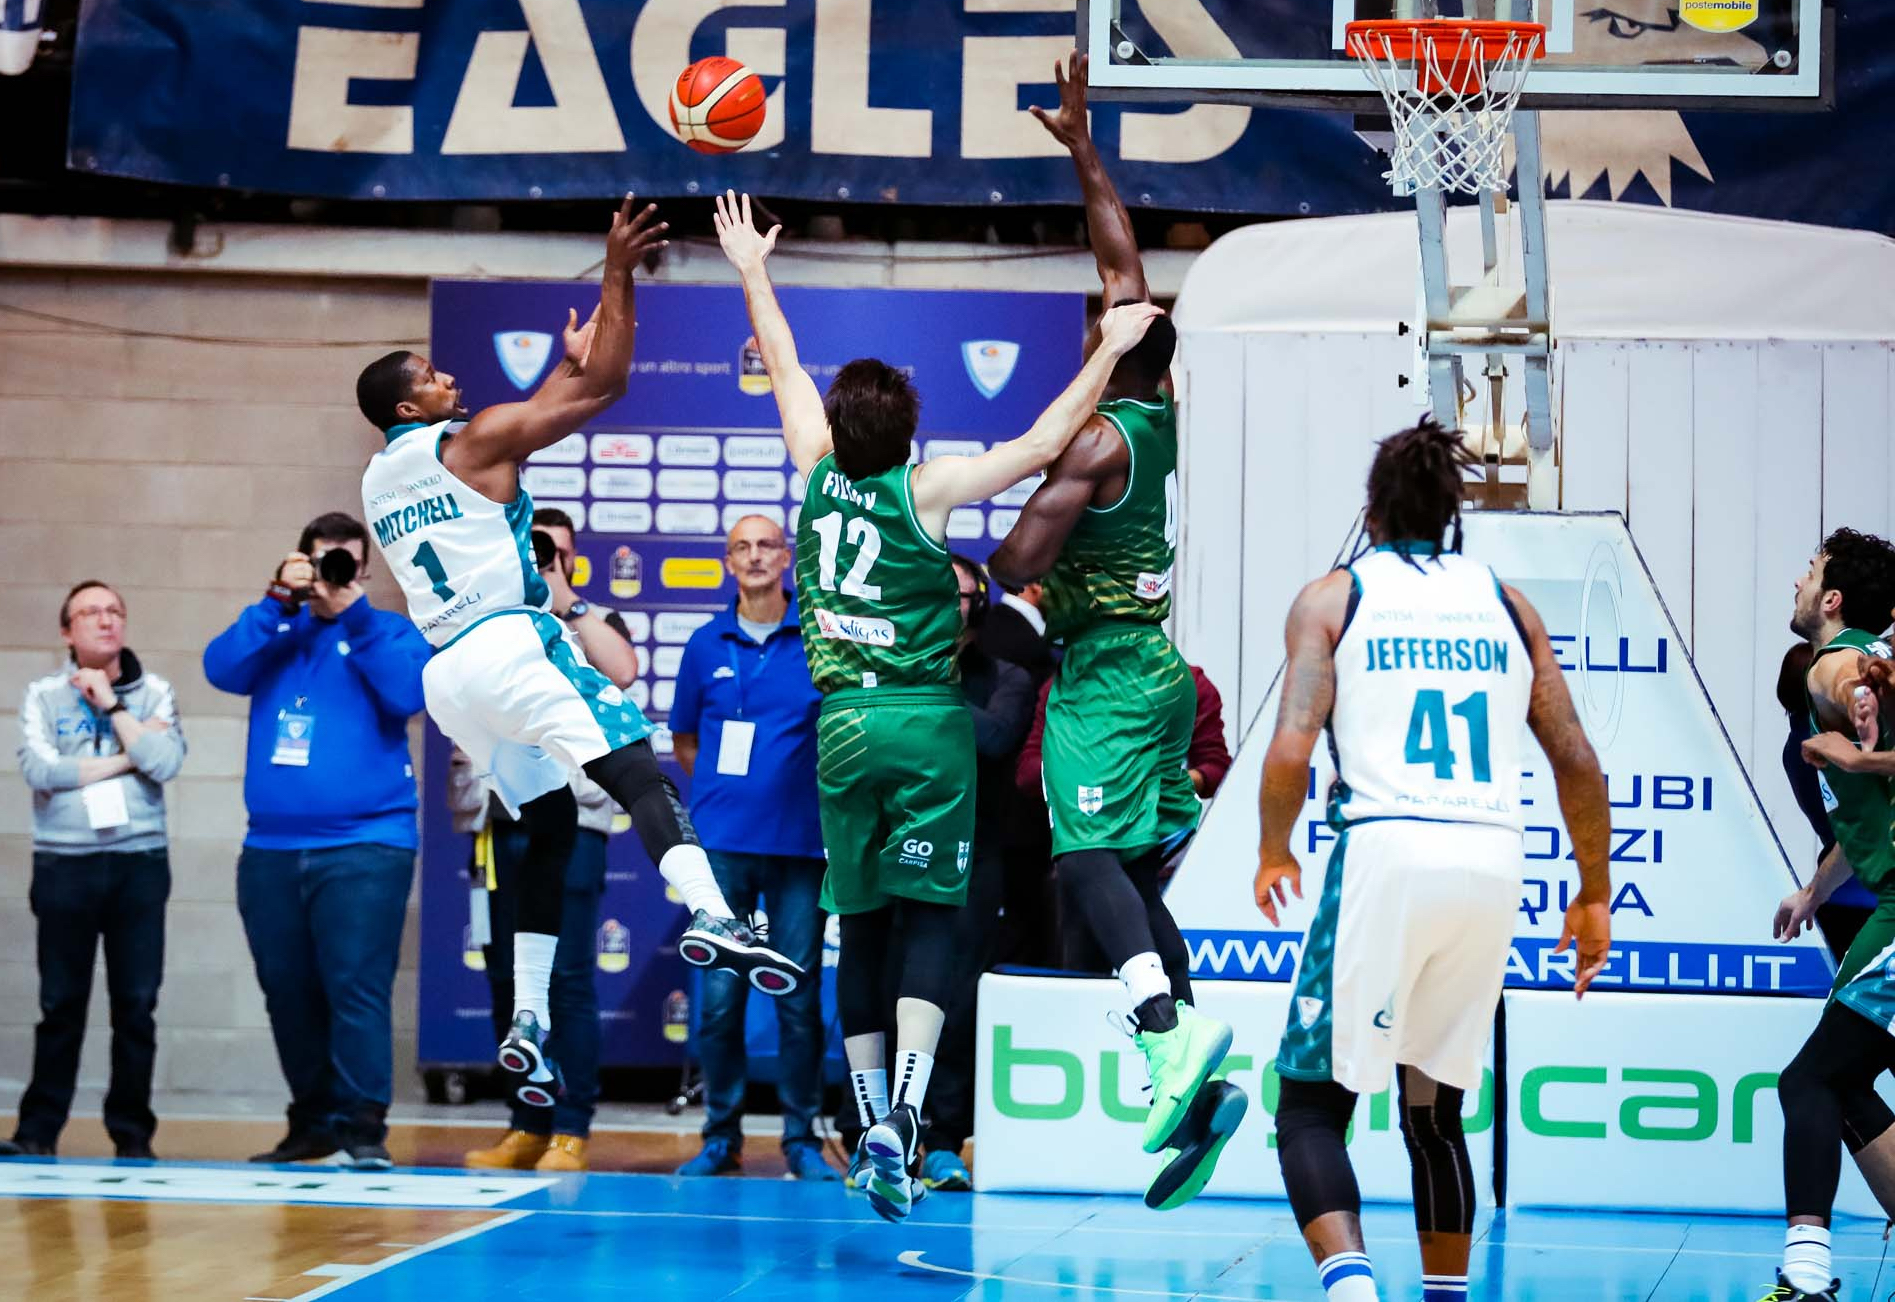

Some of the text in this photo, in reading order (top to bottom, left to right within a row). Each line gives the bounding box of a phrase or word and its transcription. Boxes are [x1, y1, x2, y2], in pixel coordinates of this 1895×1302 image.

[1685, 1, 1752, 10] postemobile
[373, 493, 464, 549] MITCHELL
[411, 540, 456, 603] 1
[811, 510, 882, 601] 12
[1366, 637, 1508, 675] JEFFERSON
[1404, 688, 1492, 784] 41
[1603, 774, 1713, 811] UBI
[902, 838, 934, 857] GO
